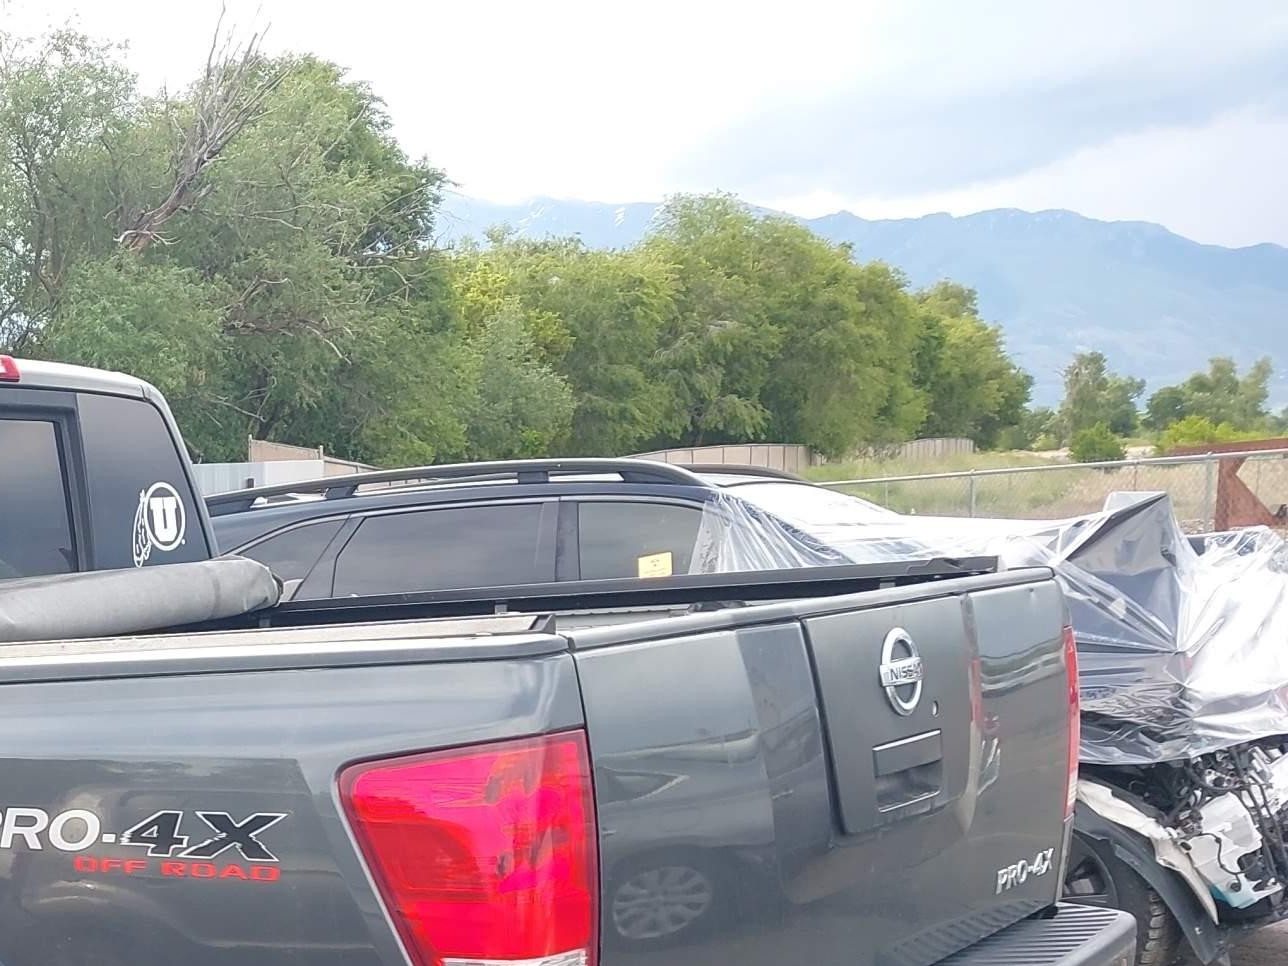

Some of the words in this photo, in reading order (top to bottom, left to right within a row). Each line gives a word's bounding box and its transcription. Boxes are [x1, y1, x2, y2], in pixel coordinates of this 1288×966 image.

[73, 855, 150, 875] OFF
[160, 860, 281, 883] ROAD
[995, 847, 1054, 895] PRO-4X
